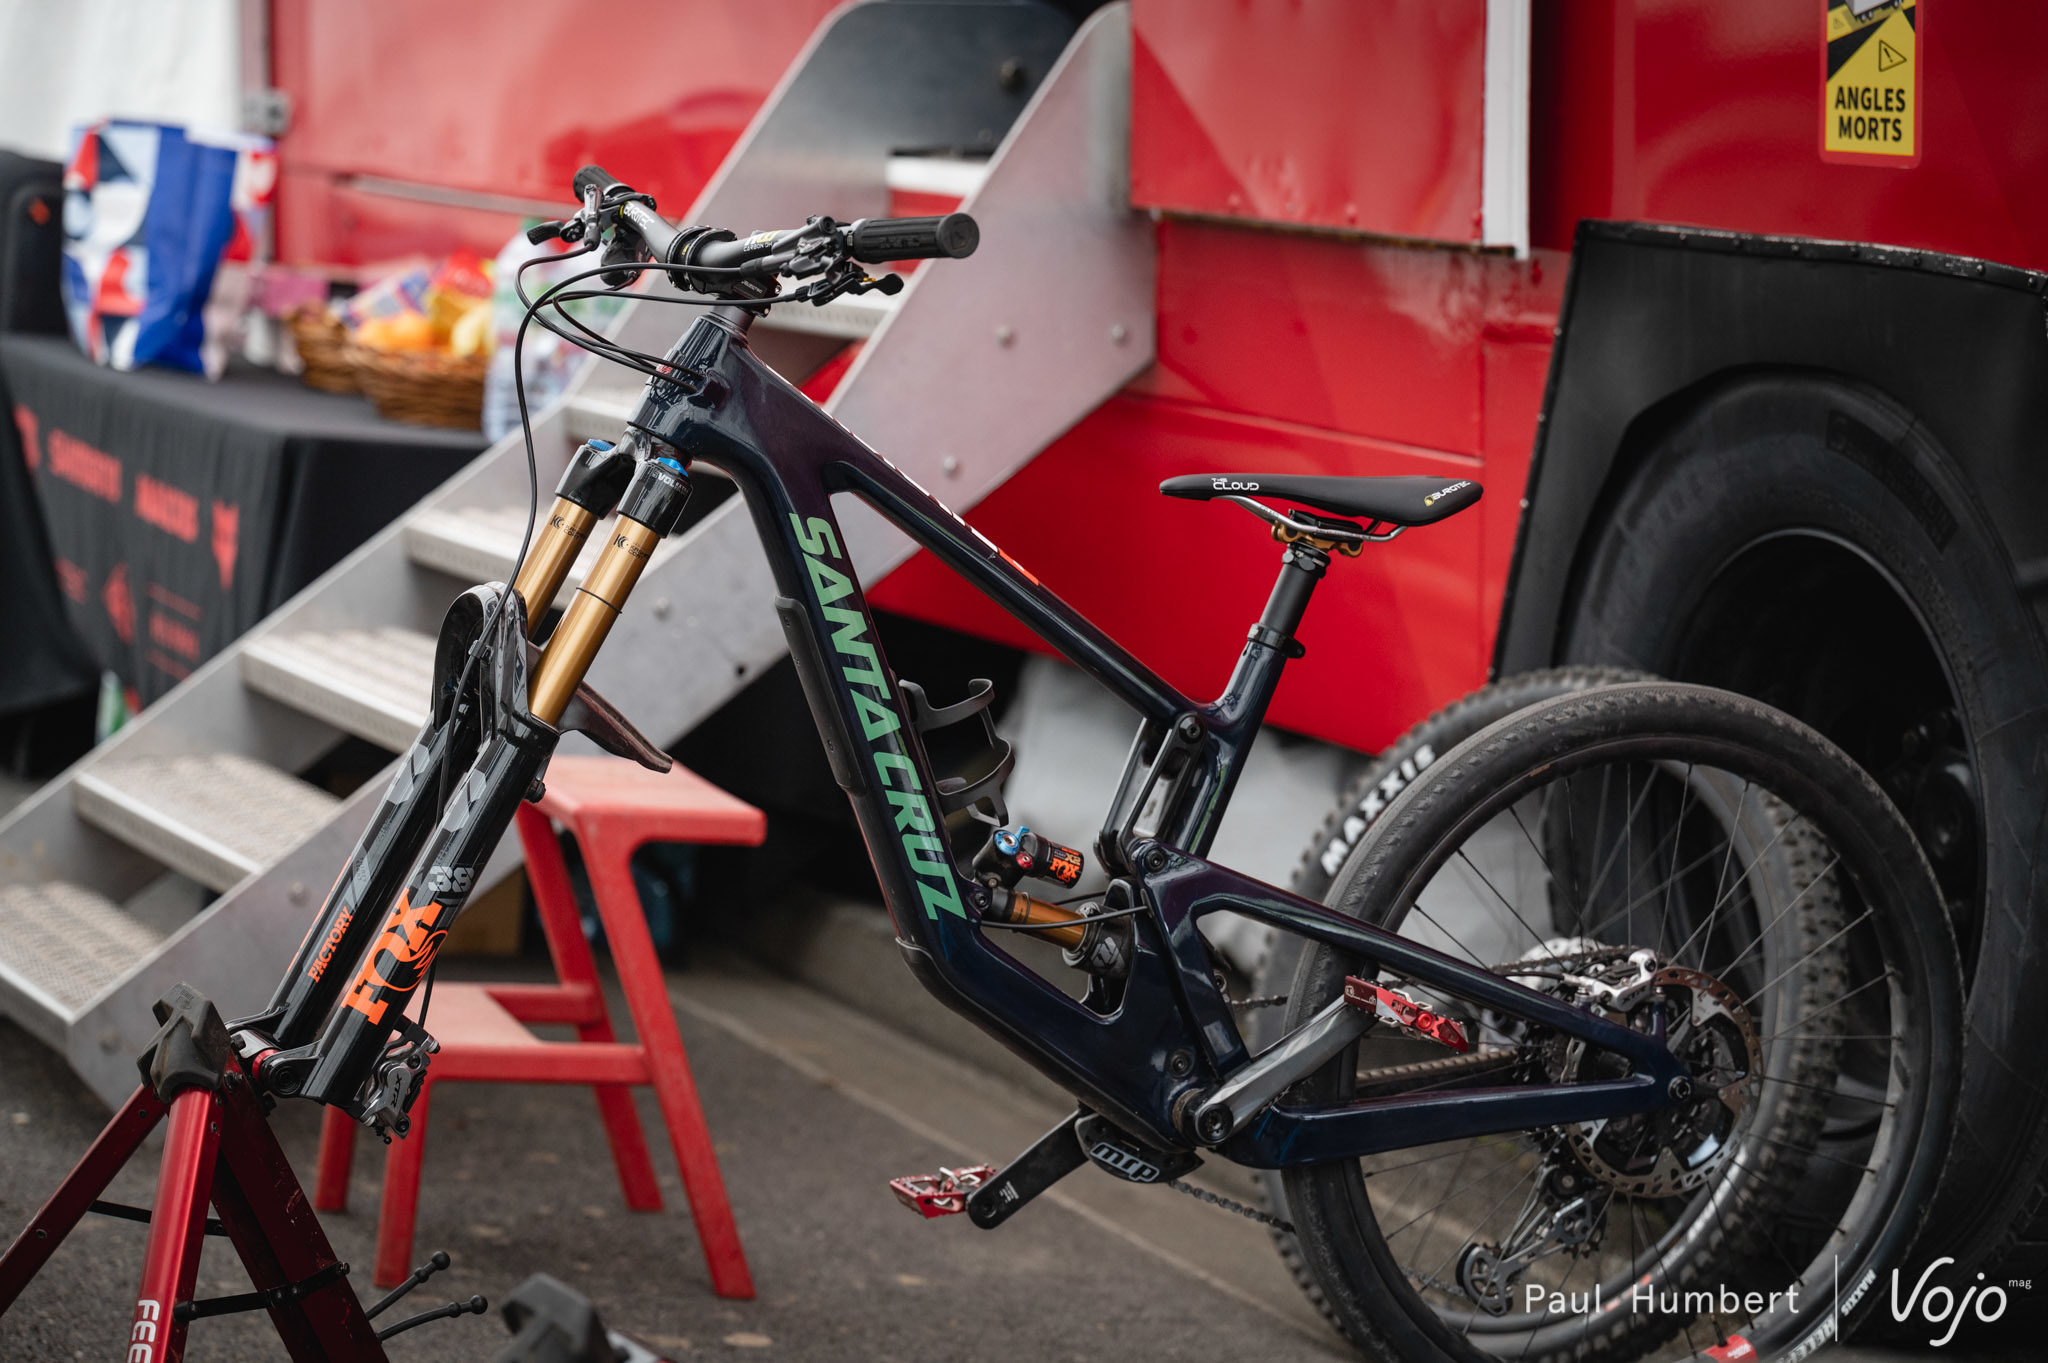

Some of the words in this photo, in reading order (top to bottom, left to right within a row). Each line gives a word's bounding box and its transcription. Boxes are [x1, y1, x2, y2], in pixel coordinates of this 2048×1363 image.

[1835, 85, 1906, 113] ANGLES
[1838, 115, 1902, 142] MORTS
[1213, 481, 1260, 491] CLOUD
[788, 512, 902, 742] SANTA
[873, 751, 968, 921] CRUZ
[1321, 744, 1436, 877] MAXXIS
[428, 865, 475, 893] 38
[1050, 857, 1080, 882] FOX
[307, 905, 354, 983] FACTORY
[341, 887, 449, 1026] FOX
[390, 1072, 403, 1109] XTR
[1090, 1142, 1160, 1182] mrp
[1841, 1269, 1877, 1316] MAXXIS
